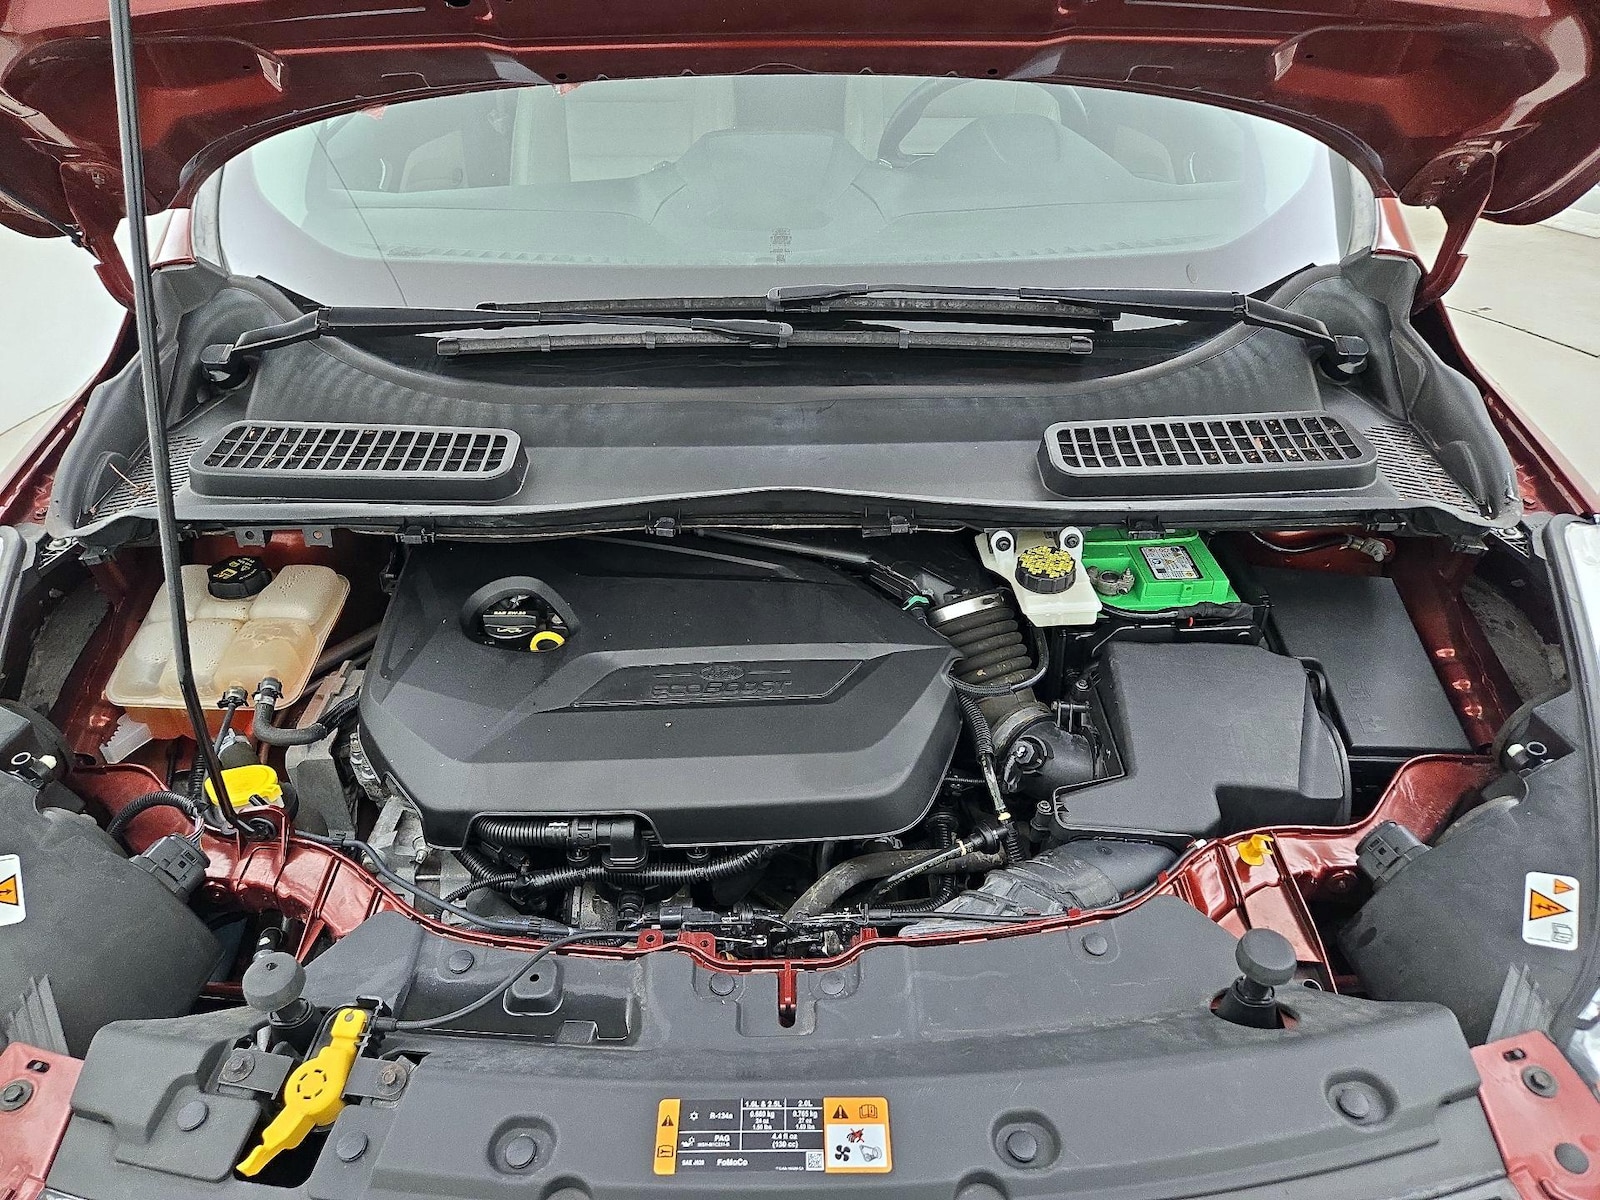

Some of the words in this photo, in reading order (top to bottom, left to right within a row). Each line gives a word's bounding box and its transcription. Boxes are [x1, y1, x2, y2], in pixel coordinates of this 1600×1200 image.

[709, 1112, 734, 1120] R-134a
[768, 1111, 775, 1119] kg
[810, 1110, 818, 1119] kg
[716, 1158, 749, 1166] FoMoCo
